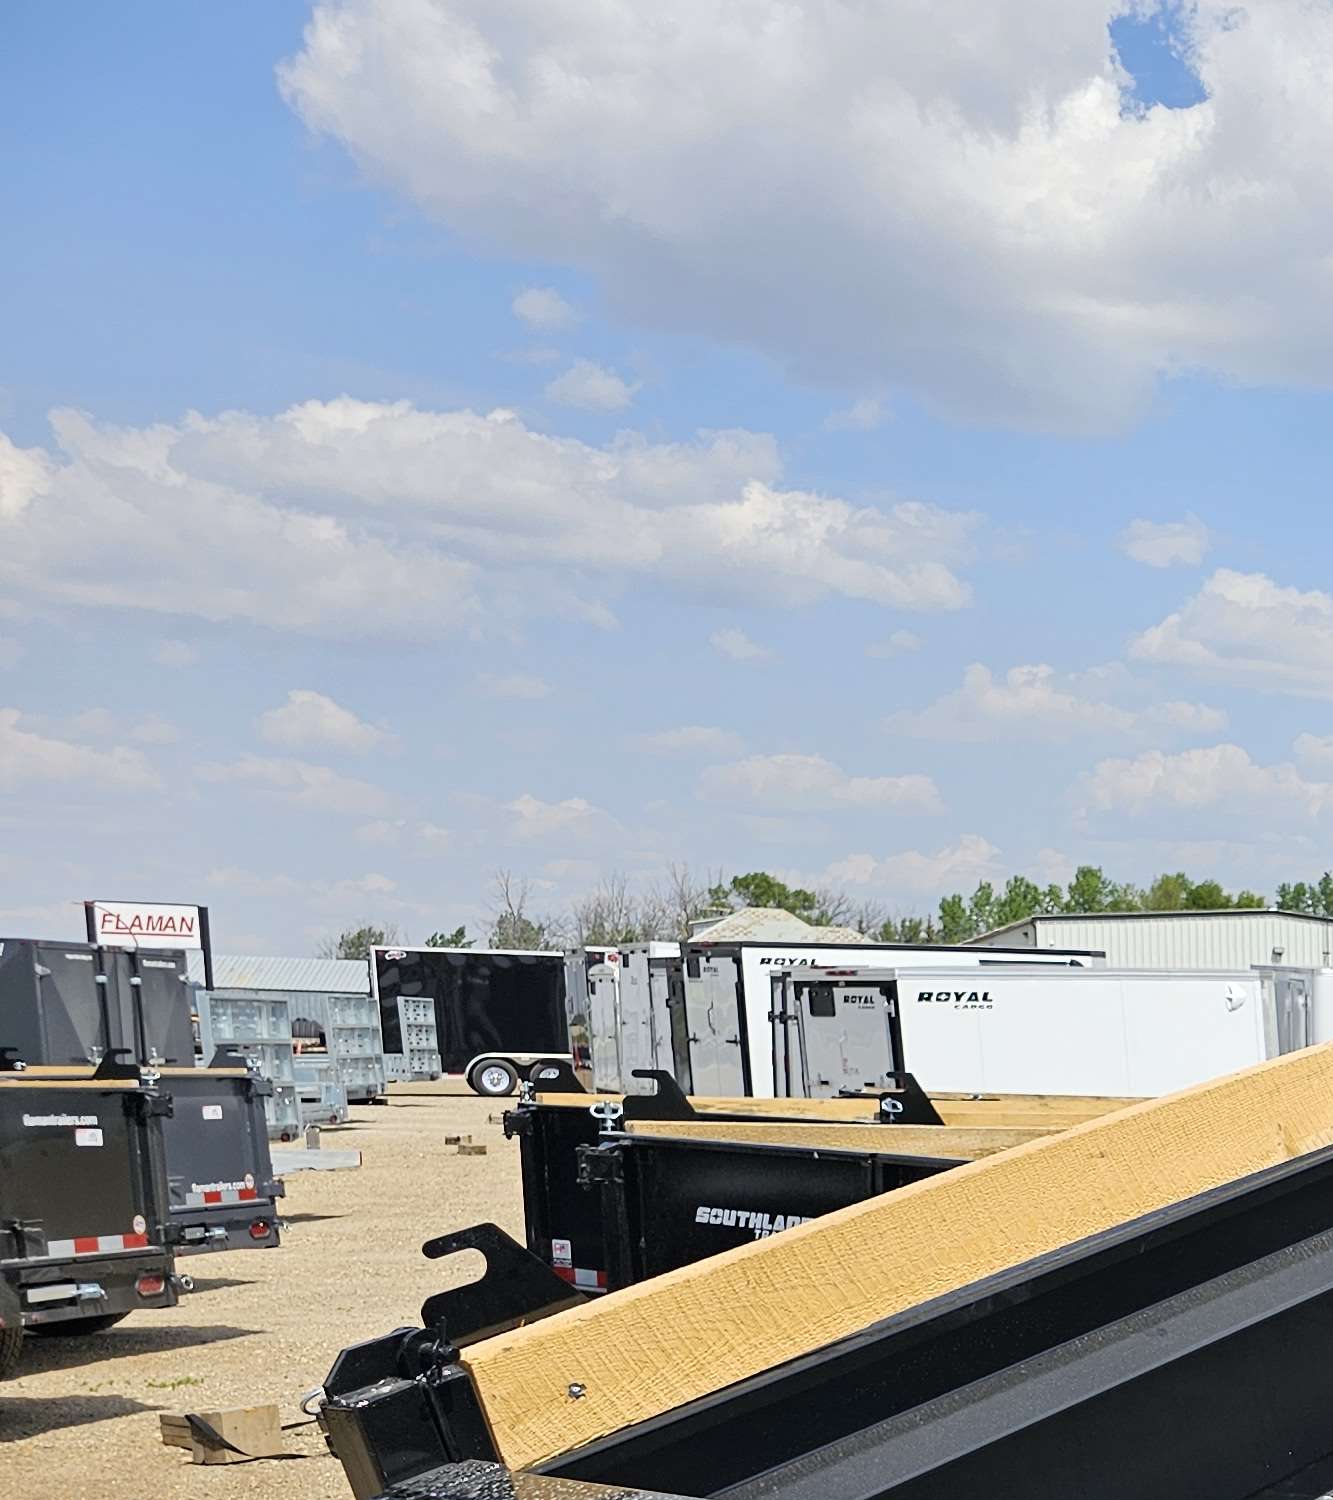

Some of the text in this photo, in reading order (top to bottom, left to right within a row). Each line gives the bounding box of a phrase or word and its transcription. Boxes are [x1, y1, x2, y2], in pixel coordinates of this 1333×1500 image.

[101, 913, 194, 932] FLAMAN
[843, 995, 875, 1005] ROYAL
[917, 991, 993, 1003] ROYAL
